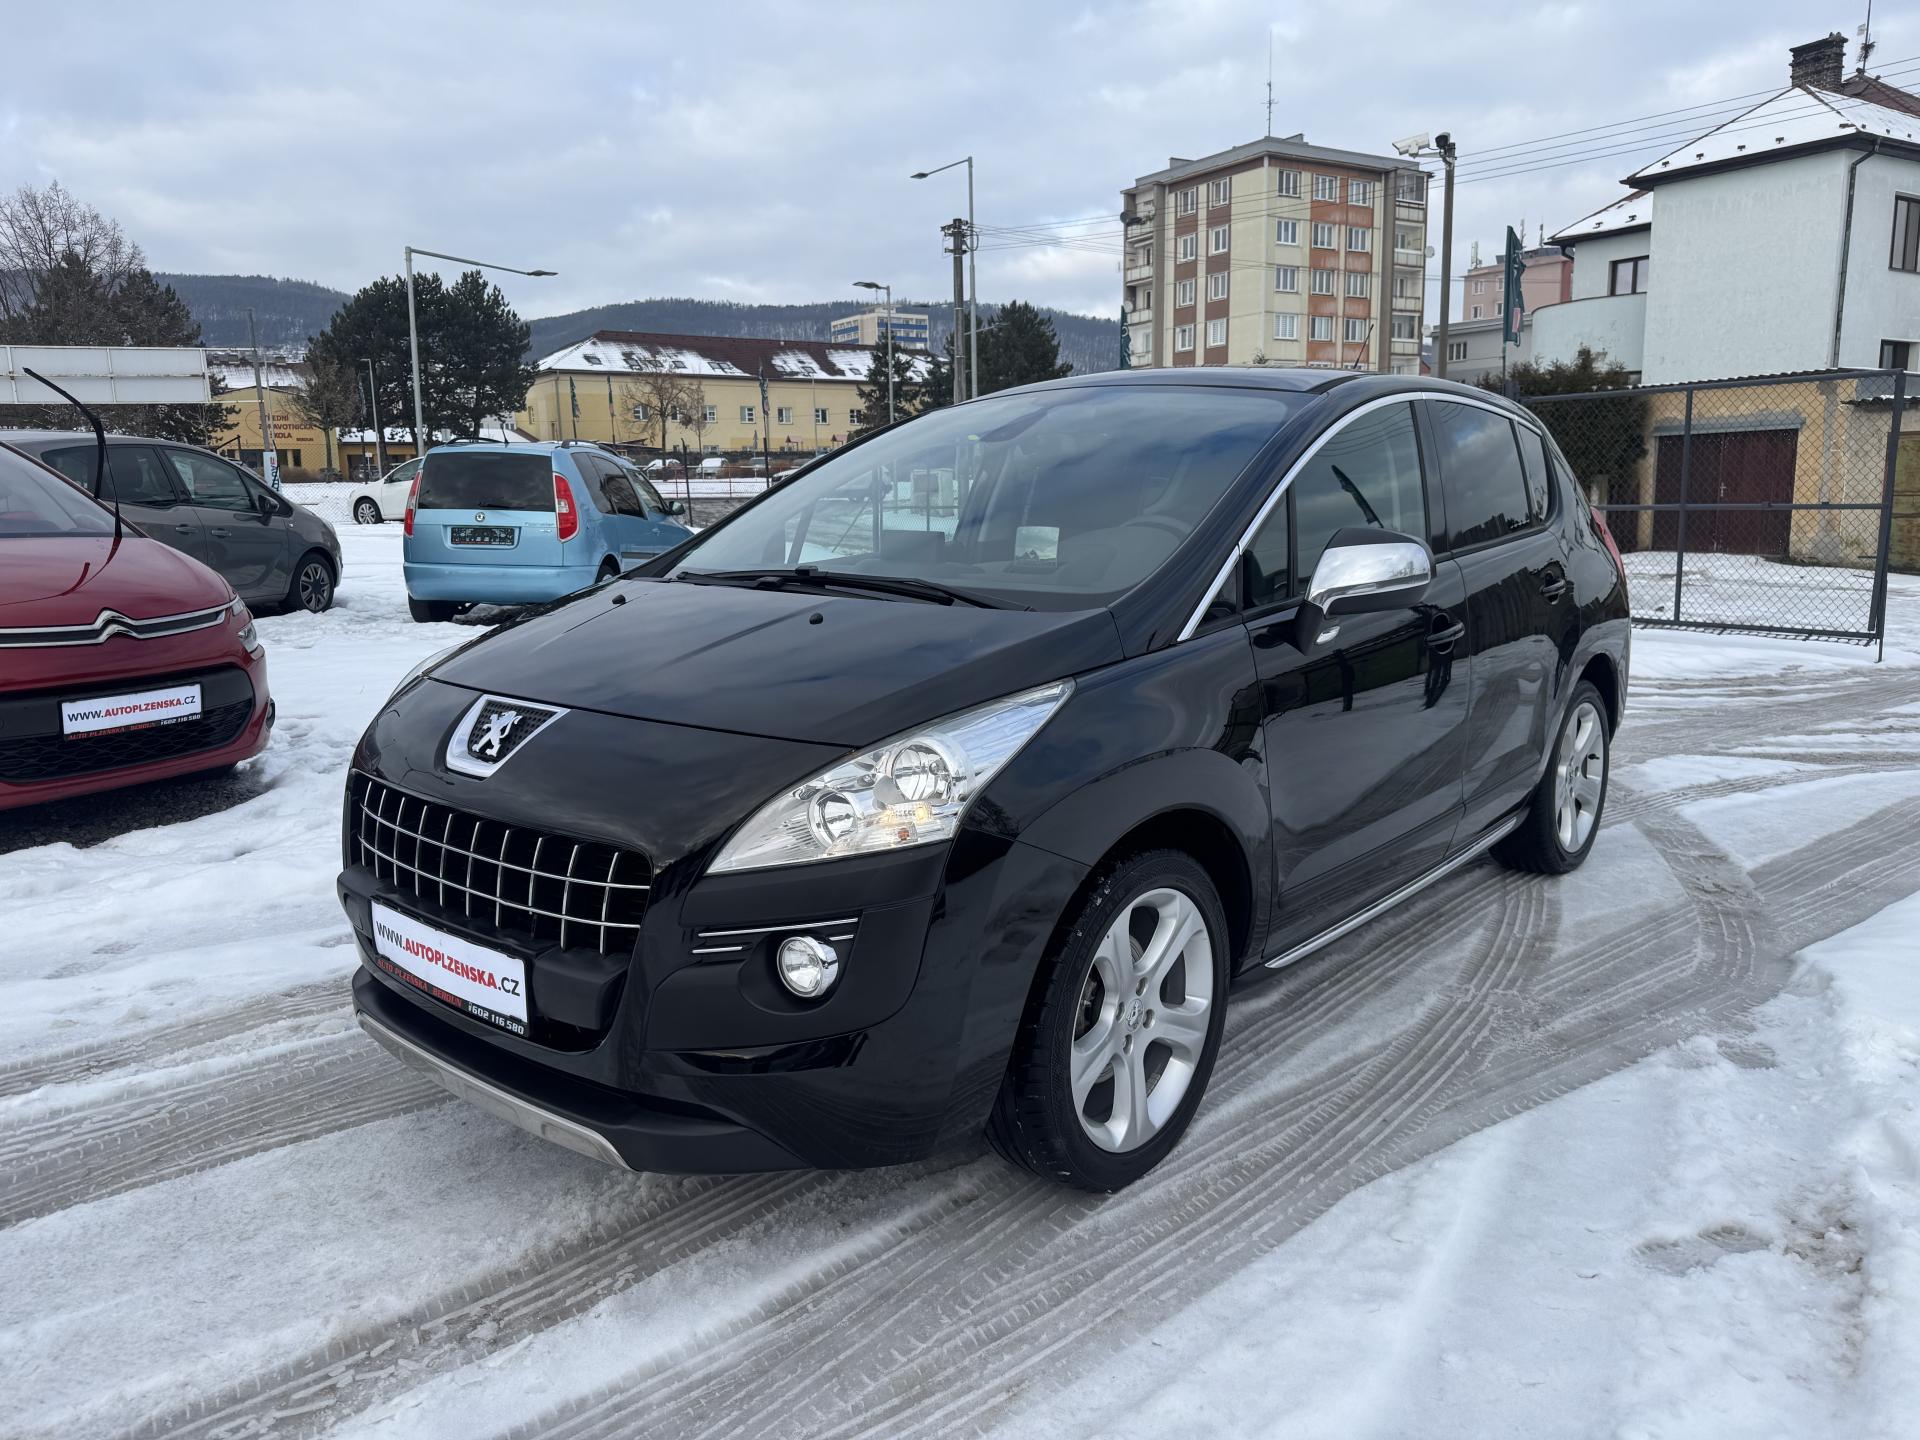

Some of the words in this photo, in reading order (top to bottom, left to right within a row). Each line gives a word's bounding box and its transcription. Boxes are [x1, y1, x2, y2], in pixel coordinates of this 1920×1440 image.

[258, 422, 313, 430] ZAVOTNICKÁ
[259, 413, 288, 421] EDNÍ
[68, 696, 196, 722] WWW.AUTOPLZENSKA.CZ
[376, 921, 521, 996] WWW.AUTOPLZENSKA.CZ
[472, 1005, 489, 1020] 602
[491, 1014, 505, 1027] 116
[506, 1020, 524, 1035] 580
